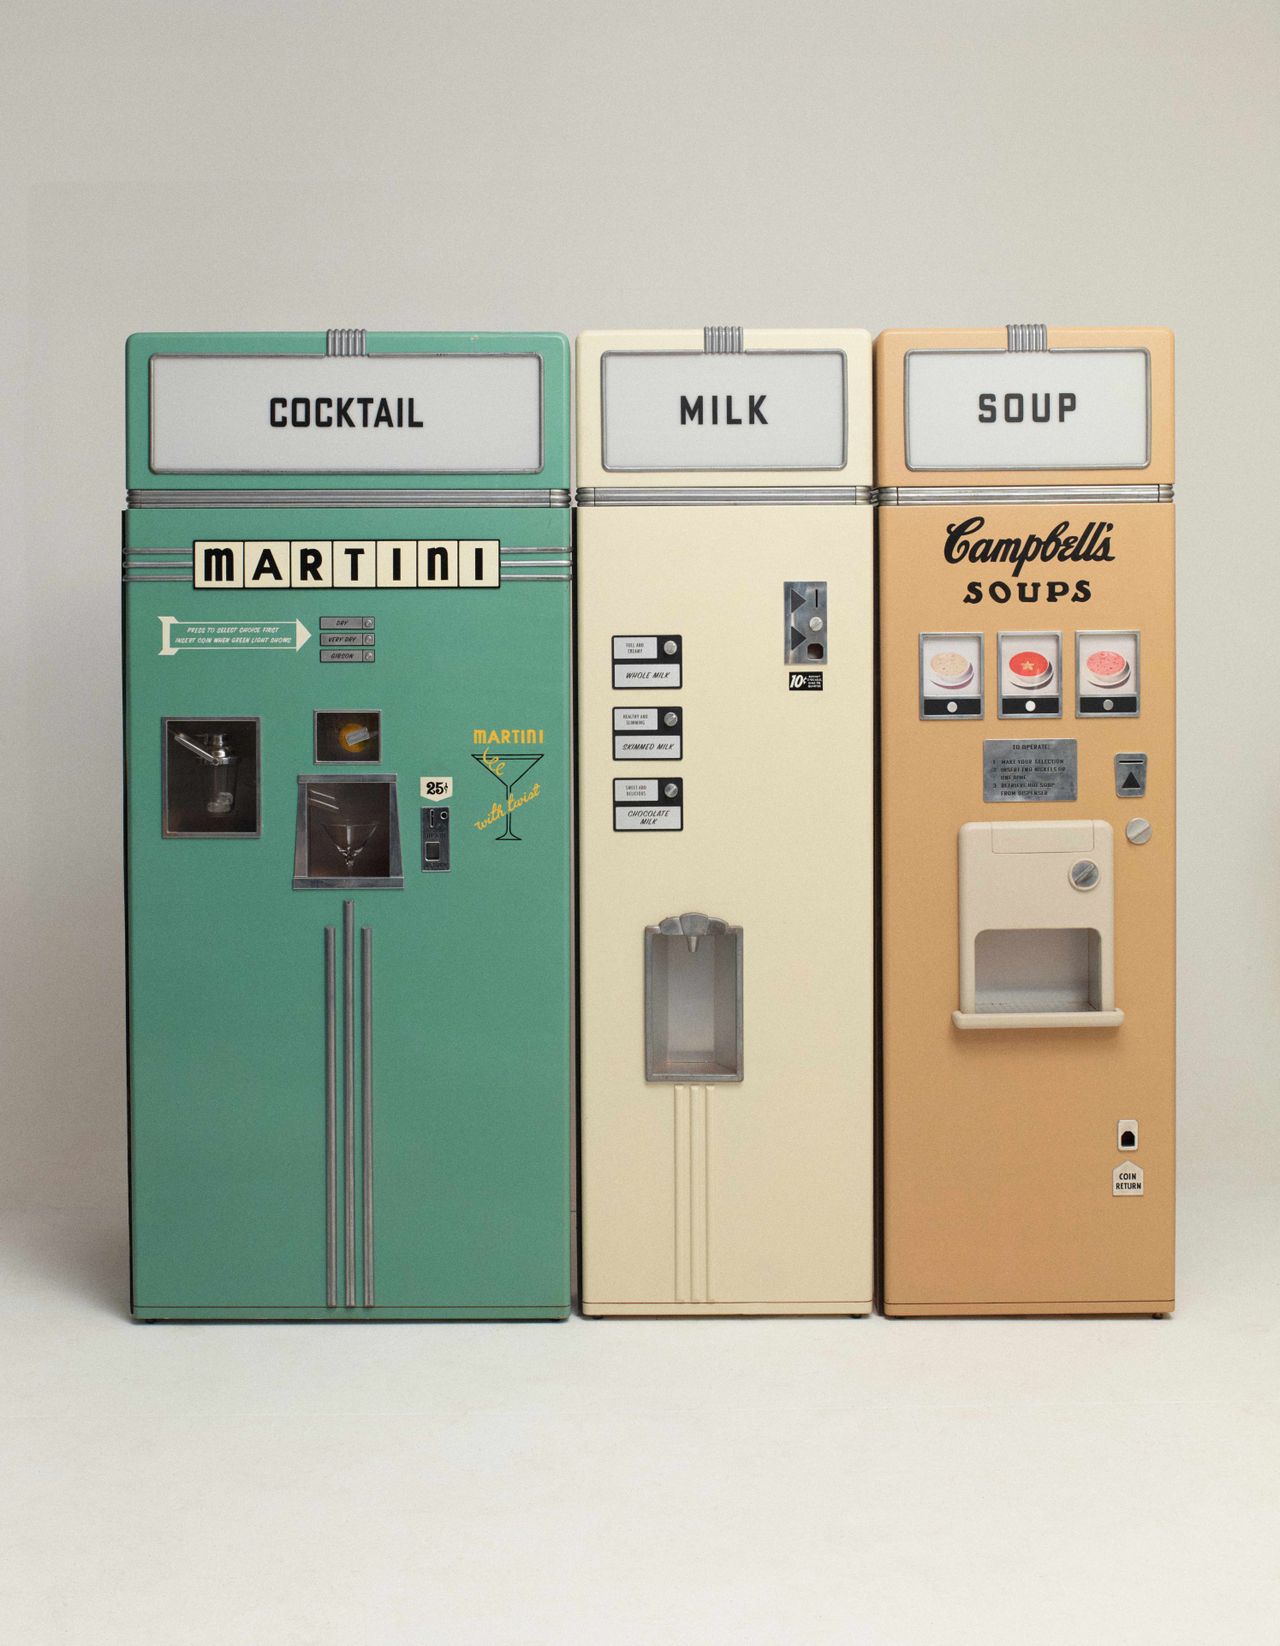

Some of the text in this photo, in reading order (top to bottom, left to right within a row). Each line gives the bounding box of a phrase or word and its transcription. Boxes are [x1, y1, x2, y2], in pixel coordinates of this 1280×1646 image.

[269, 397, 424, 428] COCKTAIL
[680, 394, 769, 426] MILK
[977, 392, 1078, 424] SOUP
[943, 516, 1116, 578] Campbell's
[204, 546, 484, 581] MARTINI
[963, 579, 1092, 604] SOUPS
[473, 728, 544, 745] MARTINI
[474, 783, 541, 830] with twist
[1118, 1172, 1137, 1181] COIN
